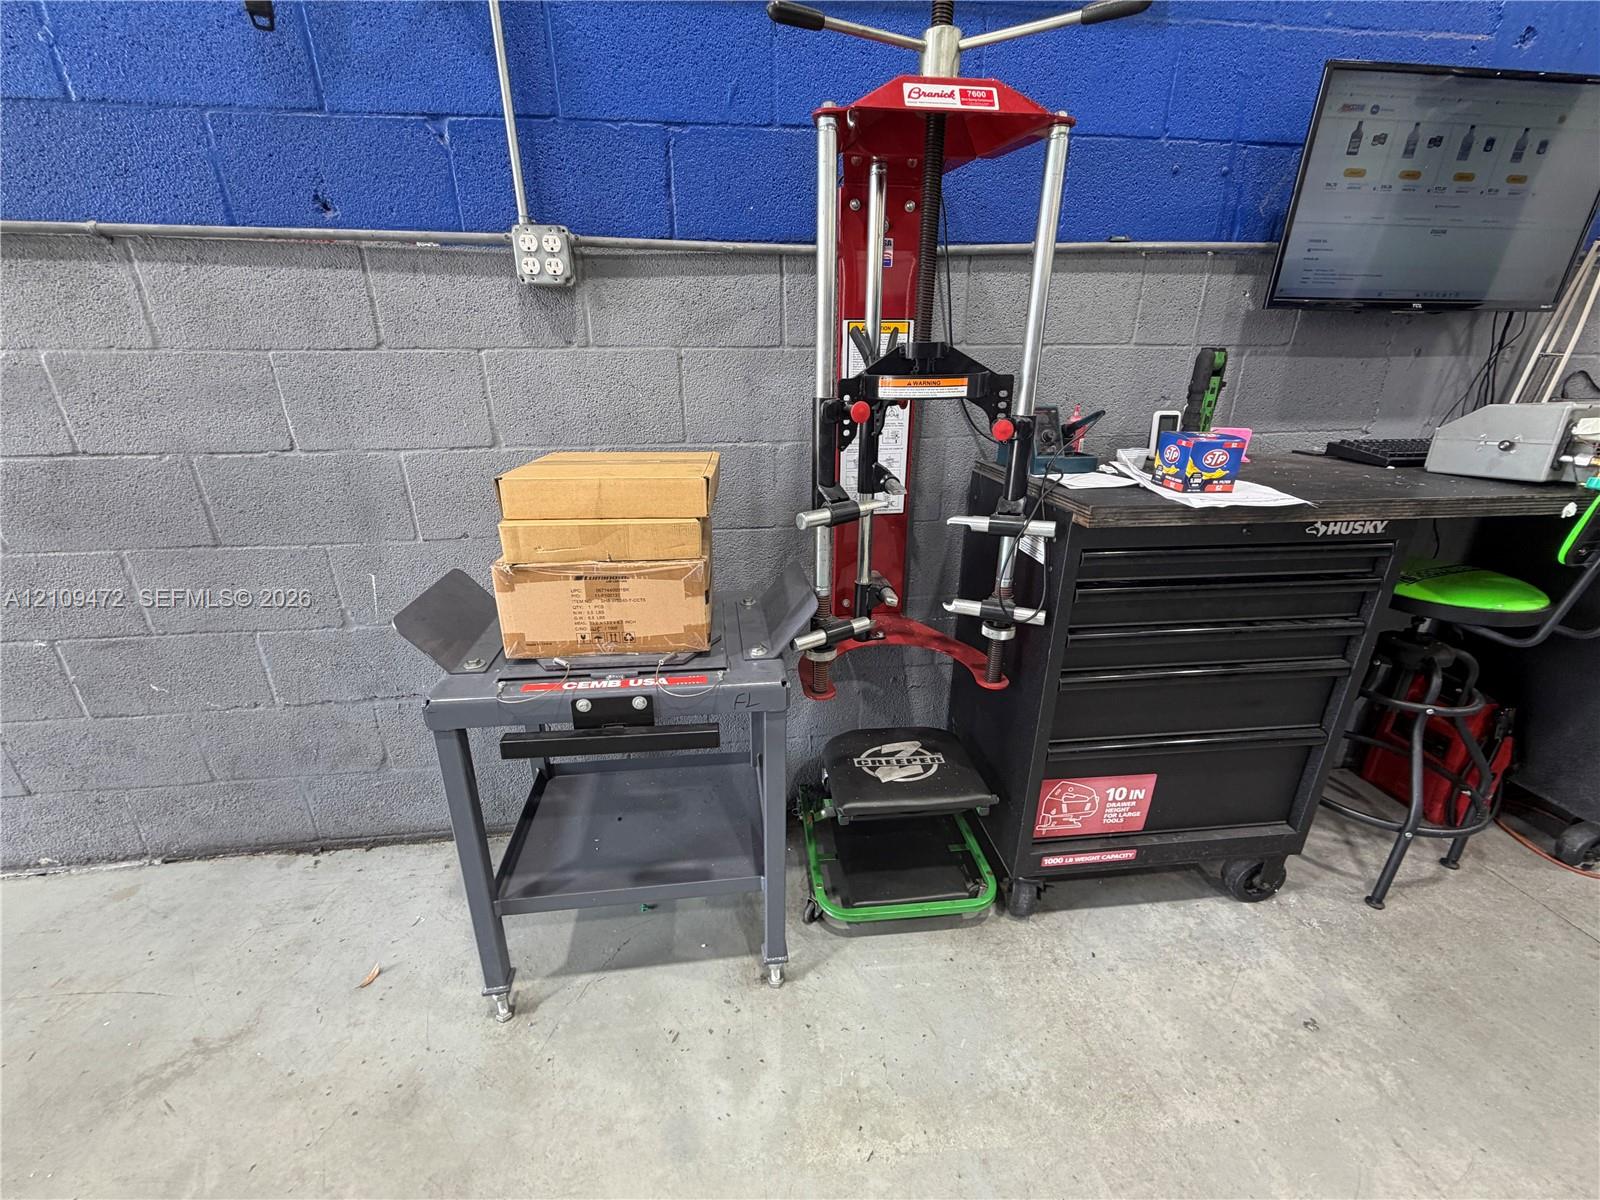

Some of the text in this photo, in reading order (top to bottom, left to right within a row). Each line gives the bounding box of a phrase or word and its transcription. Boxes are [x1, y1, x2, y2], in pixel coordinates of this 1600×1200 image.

[908, 87, 956, 100] Branick
[1165, 446, 1179, 463] STP
[1205, 451, 1227, 466] STP
[1327, 520, 1388, 535] HUSKY
[562, 677, 669, 690] CEMB USA
[856, 756, 944, 766] CREEPER
[1106, 787, 1146, 801] 10 IN
[1102, 852, 1135, 860] CAPACITY
